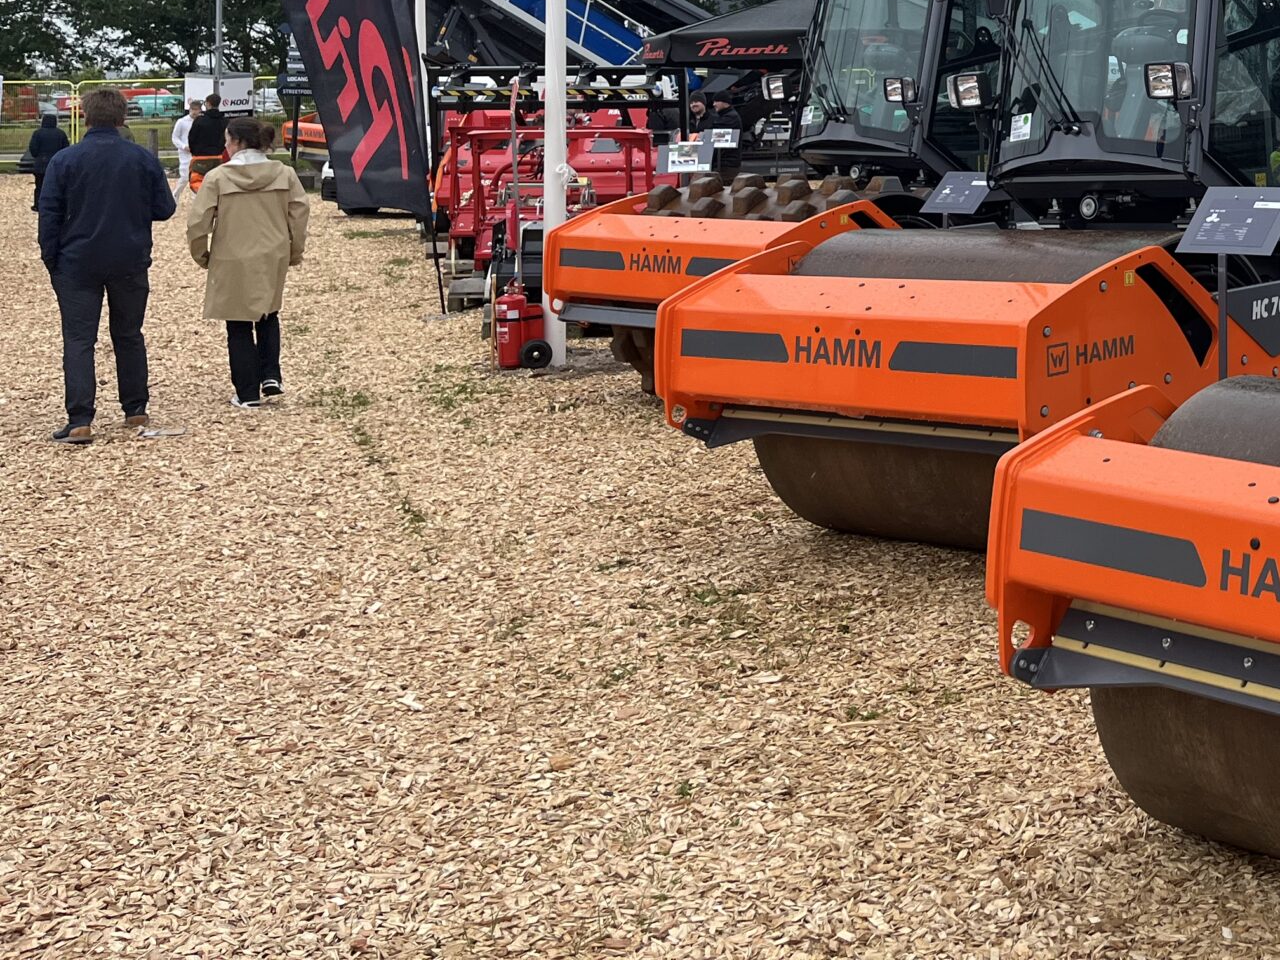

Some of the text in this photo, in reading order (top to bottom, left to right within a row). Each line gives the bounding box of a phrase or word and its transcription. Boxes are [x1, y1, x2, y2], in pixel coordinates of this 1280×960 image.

[695, 37, 789, 57] Prinoth
[629, 253, 682, 274] HAMM
[1252, 299, 1268, 320] HC
[794, 335, 882, 369] HAMM
[1075, 334, 1135, 366] HAMM
